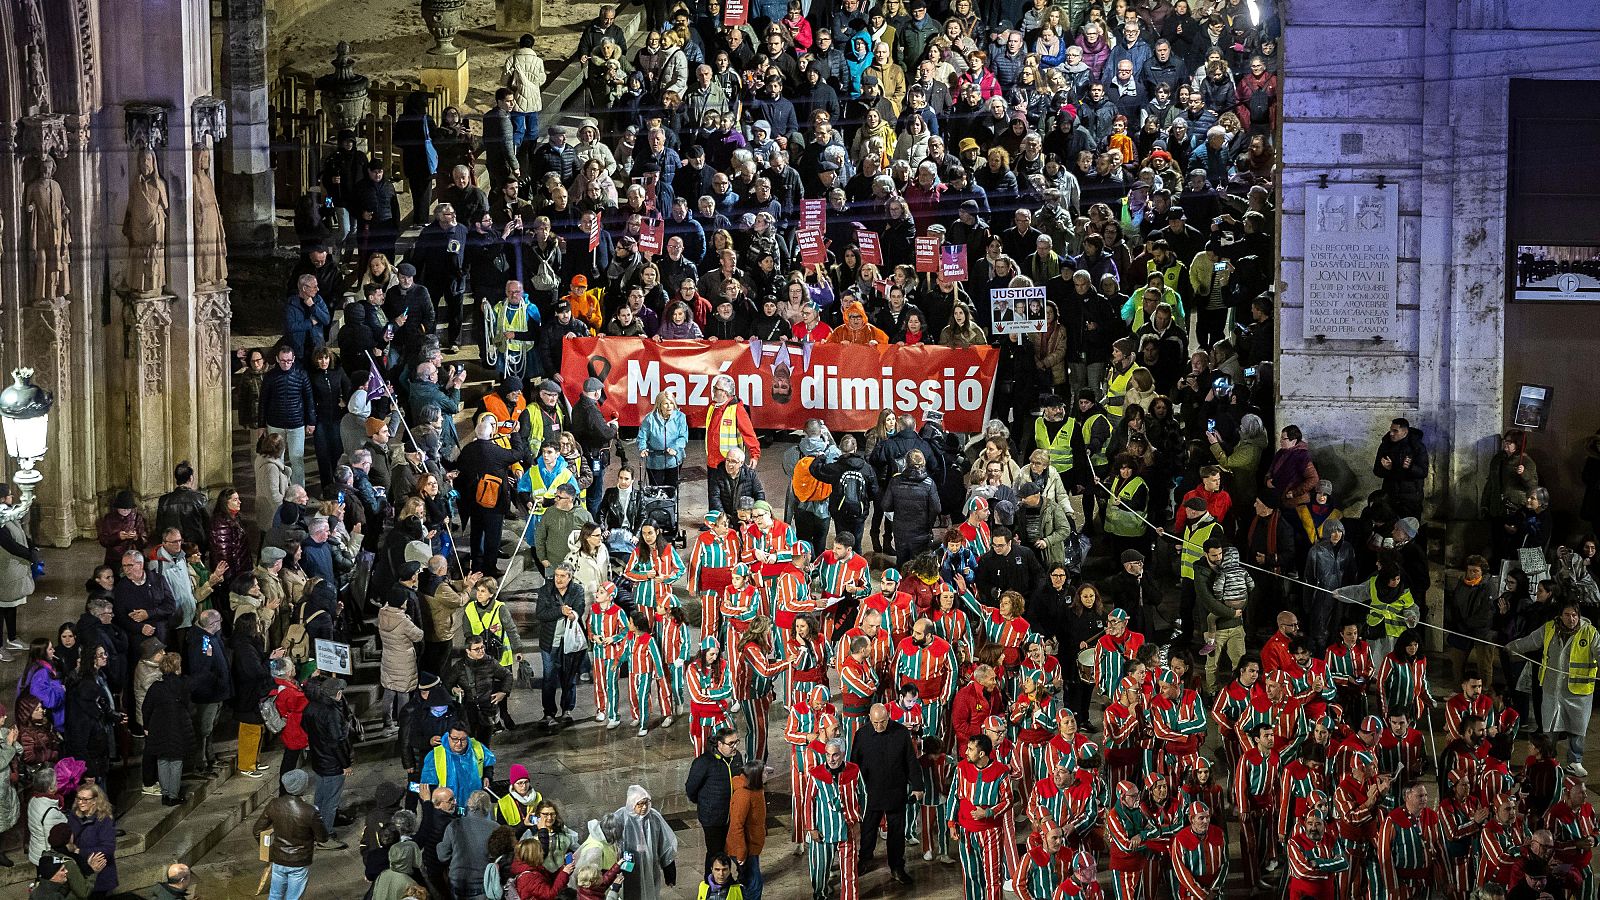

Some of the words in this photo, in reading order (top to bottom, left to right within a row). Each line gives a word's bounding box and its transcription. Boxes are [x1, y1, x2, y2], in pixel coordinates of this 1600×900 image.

[1315, 270, 1348, 281] JOAN
[993, 289, 1044, 298] JUSTICIA
[801, 364, 983, 411] dimissió
